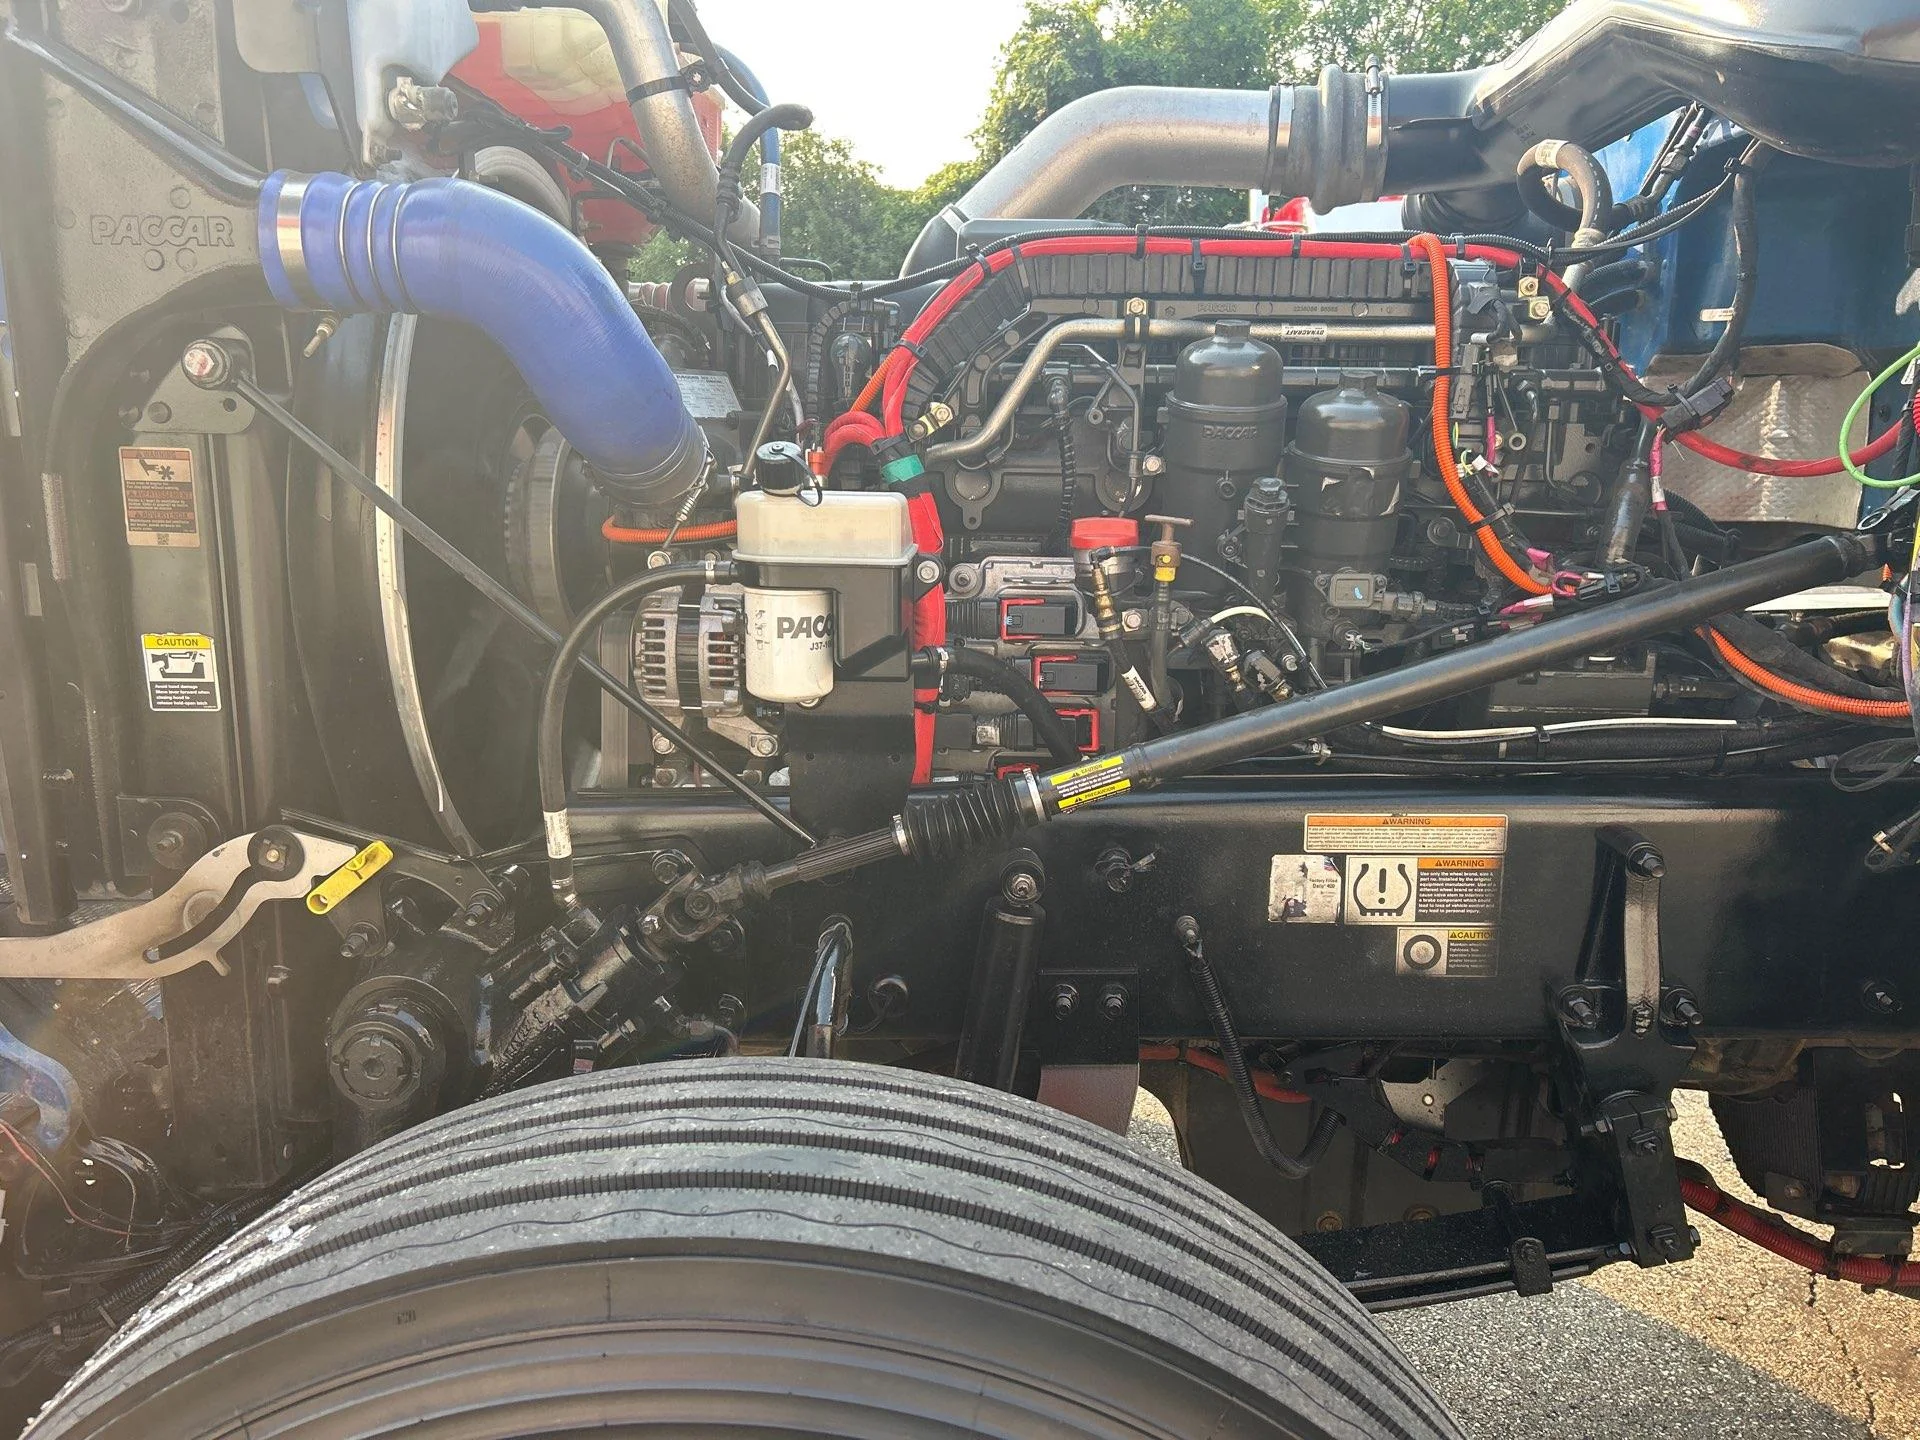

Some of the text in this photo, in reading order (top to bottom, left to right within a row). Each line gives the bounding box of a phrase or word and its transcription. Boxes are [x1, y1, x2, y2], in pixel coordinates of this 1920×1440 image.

[90, 215, 235, 247] PACCAR
[1203, 424, 1257, 438] PACCAR
[1081, 765, 1102, 773] CAUTION
